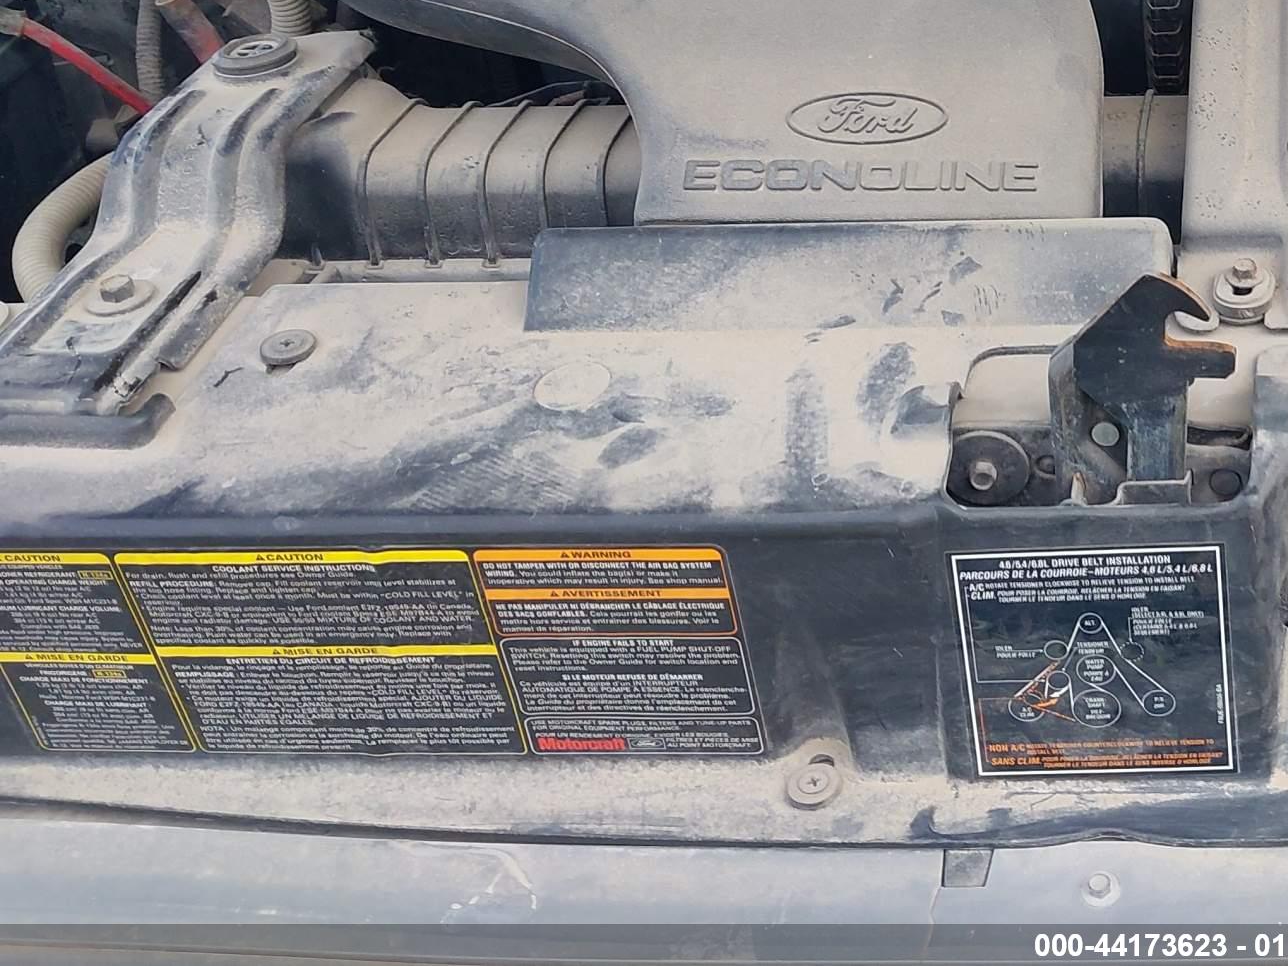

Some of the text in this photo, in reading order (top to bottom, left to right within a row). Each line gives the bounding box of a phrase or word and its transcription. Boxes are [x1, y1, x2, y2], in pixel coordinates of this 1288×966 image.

[817, 99, 919, 135] Ford
[683, 159, 1039, 191] ECONOLINE
[4, 554, 61, 562] CAUTION
[1051, 558, 1080, 568] DRIVE
[1081, 556, 1104, 566] BELT
[1106, 555, 1171, 566] INSTALLATION
[212, 564, 376, 574] COOLANT SERVICE INSTRUCTIONS
[608, 570, 634, 578] bag(s)
[960, 570, 1010, 580] PARCOURS
[1012, 570, 1024, 579] DE
[1026, 569, 1038, 578] LA
[620, 578, 647, 586] injury.
[969, 584, 985, 592] A/C
[970, 591, 996, 600] CLIM.
[36, 654, 66, 662] MISE
[226, 657, 278, 665] ENTRETIEN
[350, 656, 436, 665] REFROIDISSEMENT
[537, 738, 626, 751] Motorcraft
[989, 744, 1008, 752] NON
[1010, 744, 1026, 752] A/C
[991, 758, 1016, 766] SANS
